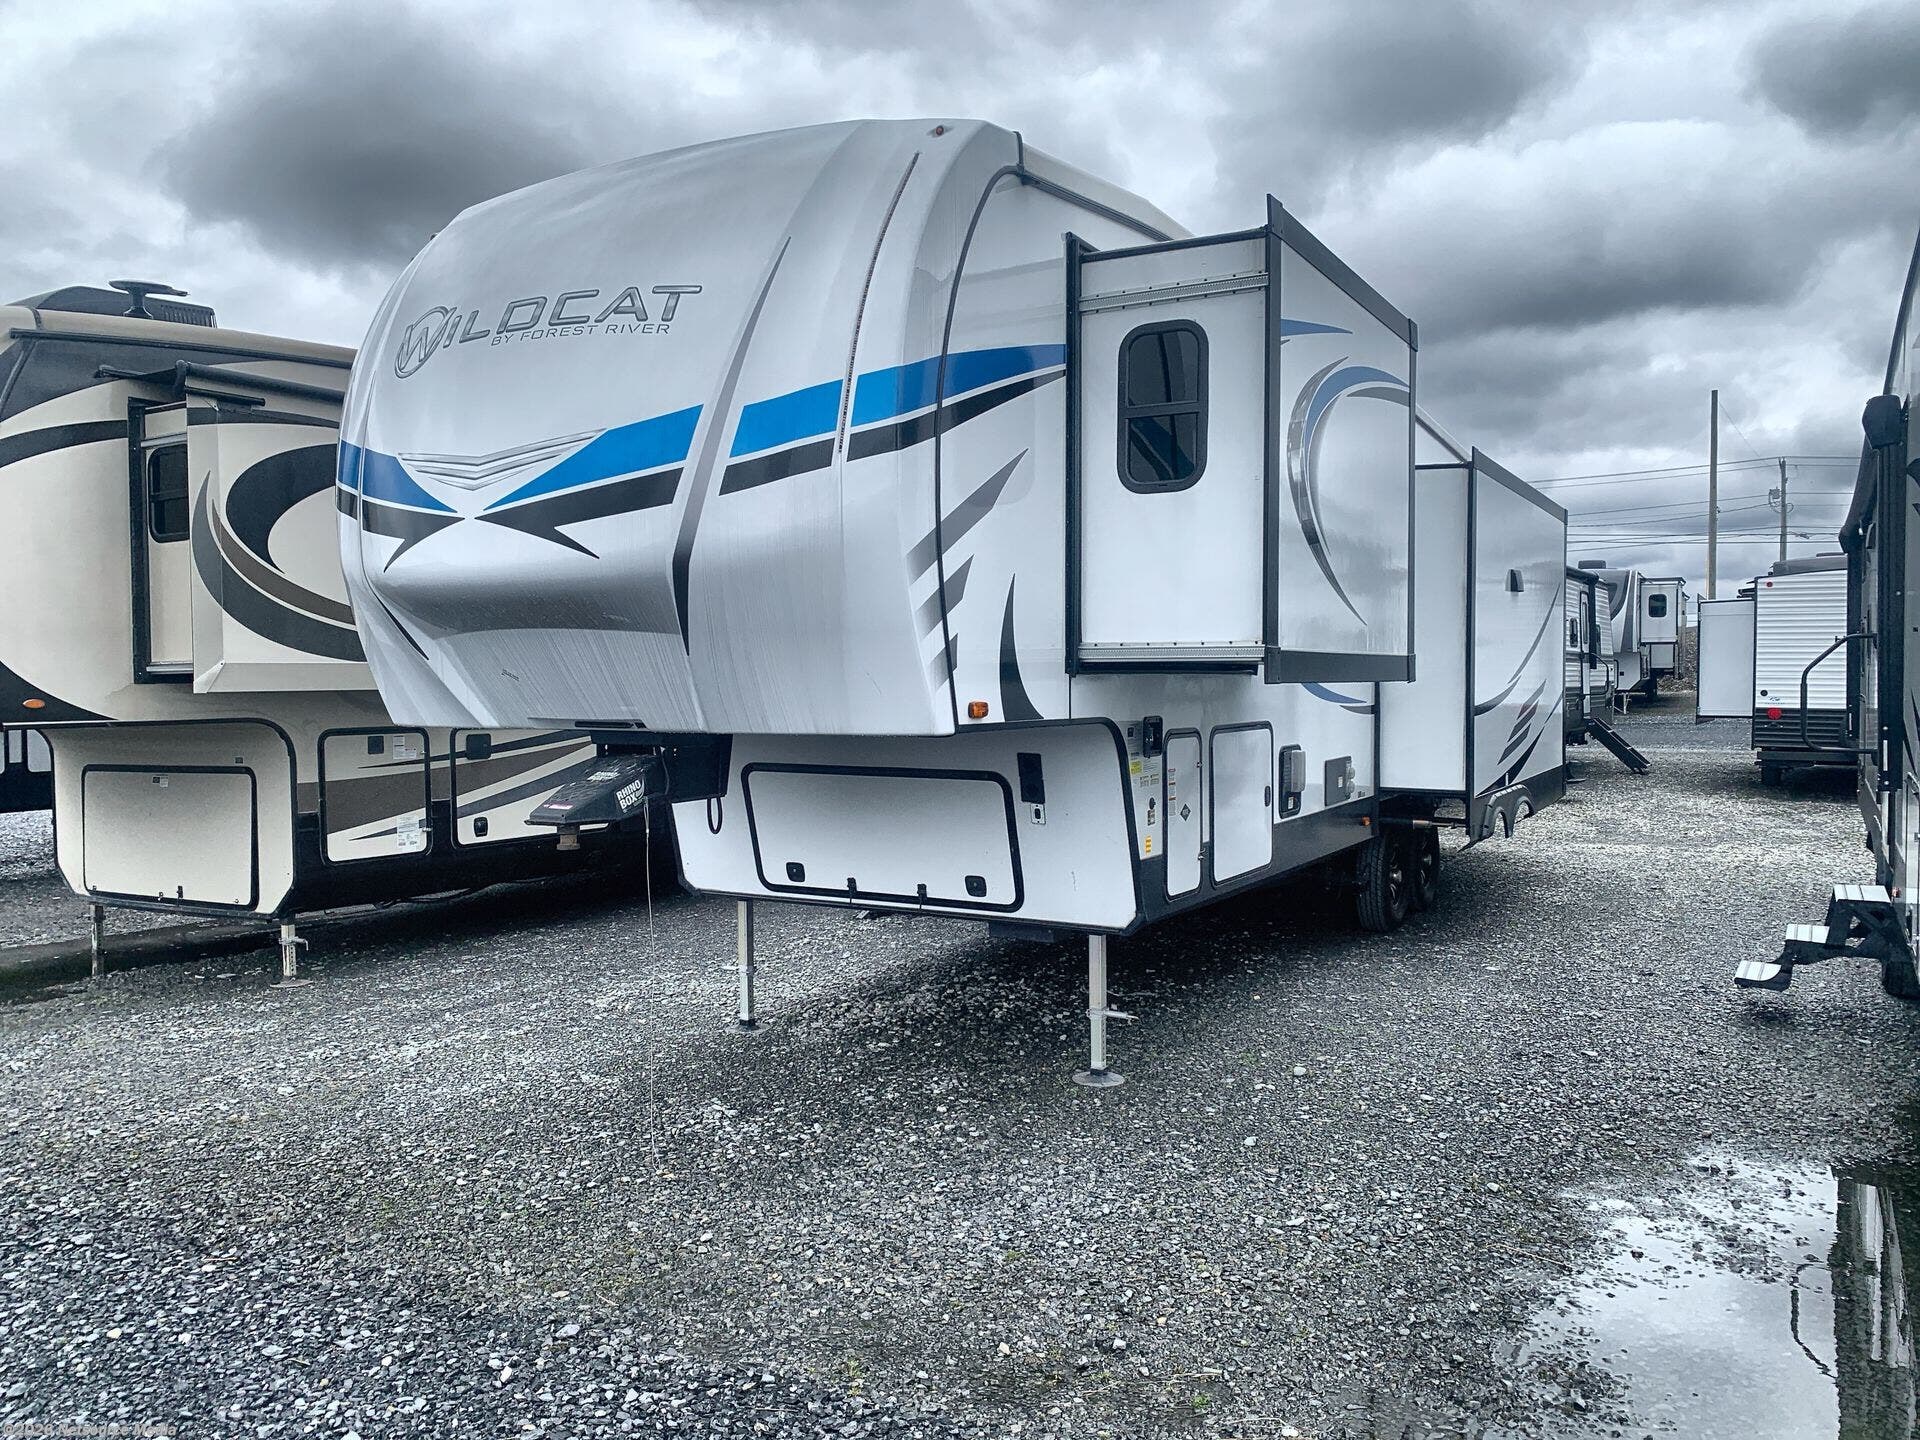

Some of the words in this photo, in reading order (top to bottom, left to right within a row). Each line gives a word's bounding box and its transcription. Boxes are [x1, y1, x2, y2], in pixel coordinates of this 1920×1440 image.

[395, 285, 702, 379] WILDCAT
[491, 334, 513, 346] BY
[520, 325, 598, 341] FOREST
[605, 323, 670, 335] RIVER
[616, 780, 641, 801] RHINO
[619, 793, 637, 810] BOX
